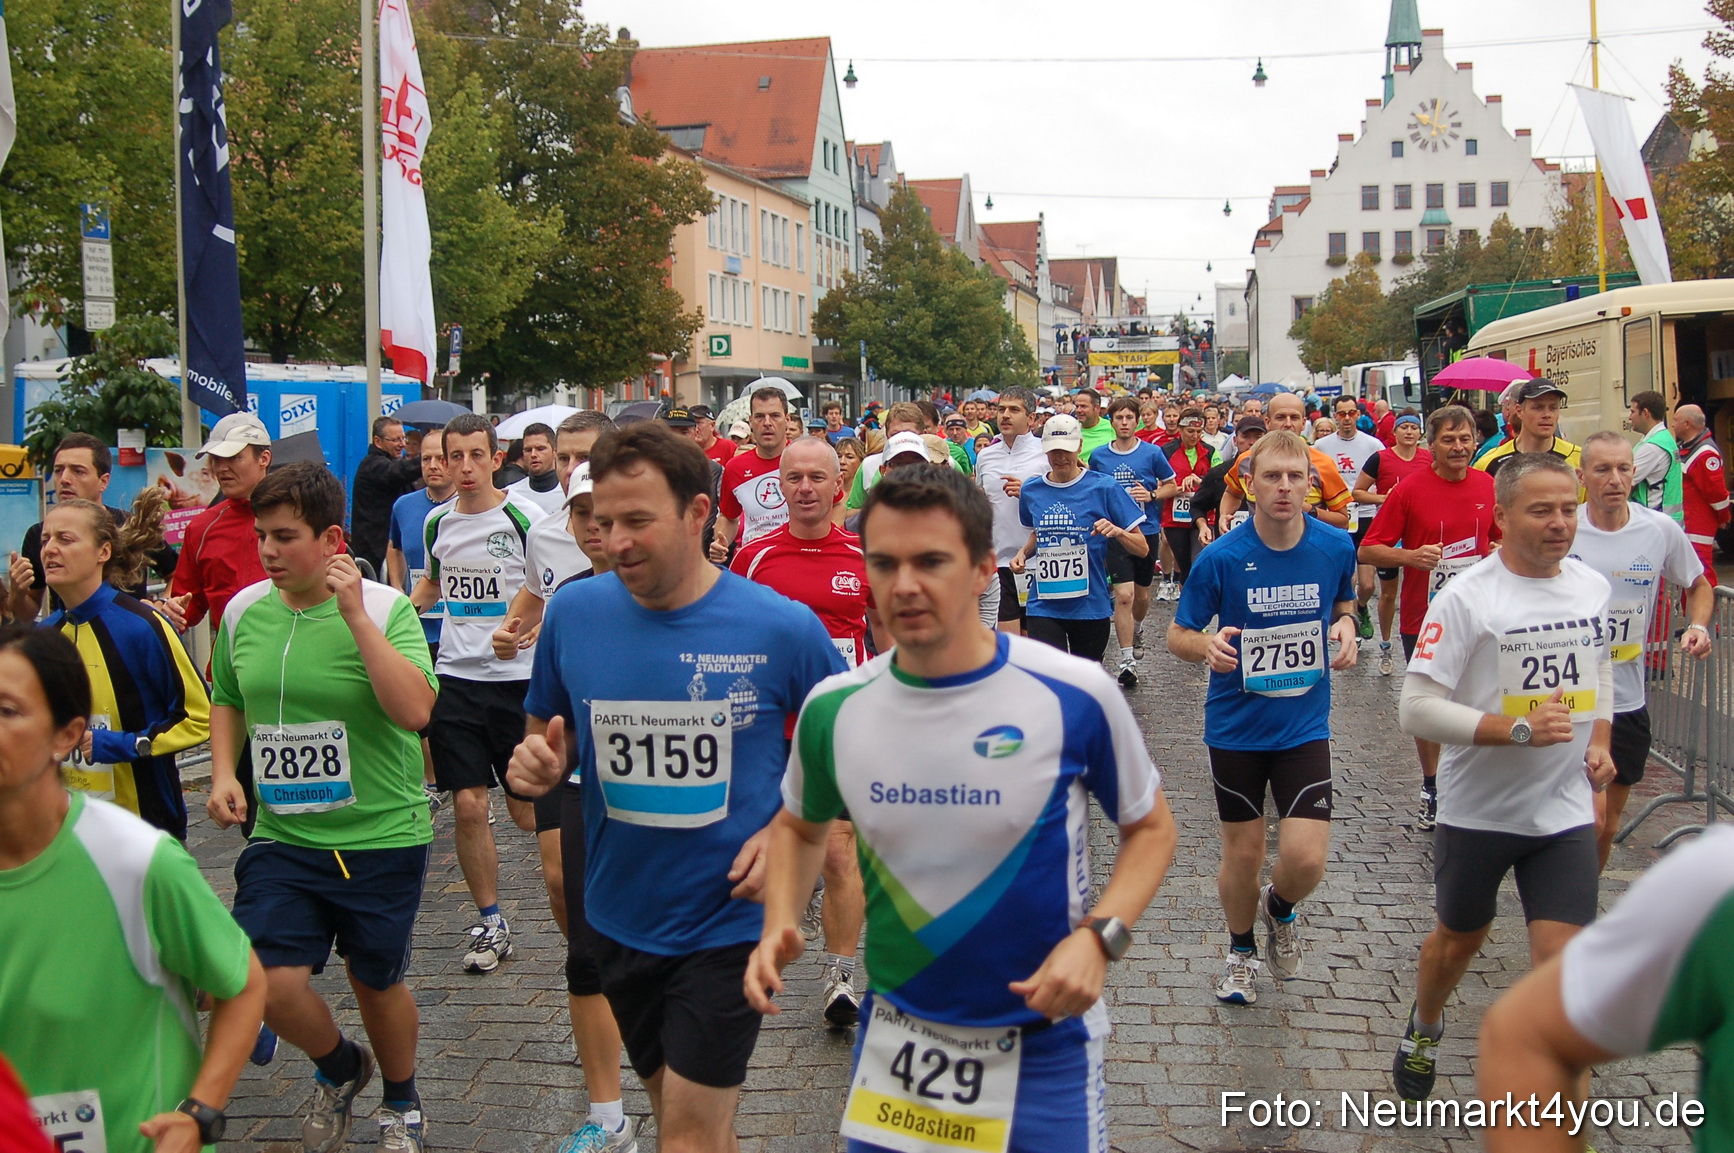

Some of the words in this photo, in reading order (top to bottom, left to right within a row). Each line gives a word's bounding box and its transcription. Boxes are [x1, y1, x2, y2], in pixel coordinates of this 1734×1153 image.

[712, 337, 728, 354] D
[1546, 337, 1596, 366] Bayerisches
[1117, 354, 1149, 363] START
[1176, 499, 1190, 511] 26
[462, 566, 491, 574] Neumarkt
[1039, 558, 1084, 579] 3075
[447, 575, 500, 600] 2504
[1025, 573, 1035, 590] 2
[1247, 583, 1319, 604] HUBER
[464, 605, 483, 615] Dirk
[1263, 600, 1317, 610] TECHNOLOGY
[1243, 635, 1270, 644] PARTL
[1271, 630, 1308, 641] Neumarkt
[1607, 618, 1630, 642] 61
[1500, 642, 1534, 653] PARTL
[1536, 638, 1578, 650] Neumarkt
[679, 653, 696, 663] 12.
[697, 654, 768, 664] NEUMARKTER
[1250, 640, 1316, 673] 2759
[695, 663, 754, 673] STADTLAUF
[1521, 652, 1580, 691] 254
[1264, 675, 1305, 689] Thomas
[594, 714, 638, 726] PARTL
[641, 715, 705, 727] Neumarkt
[282, 732, 328, 742] Neumarkt
[261, 744, 342, 780] 2828
[608, 732, 719, 780] 3159
[274, 786, 333, 802] Christoph
[870, 781, 1001, 806] Sebastian
[874, 1007, 918, 1033] PARTL
[921, 1026, 990, 1050] Neumarkt
[889, 1040, 985, 1106] 429
[876, 1101, 977, 1143] Sebastian
